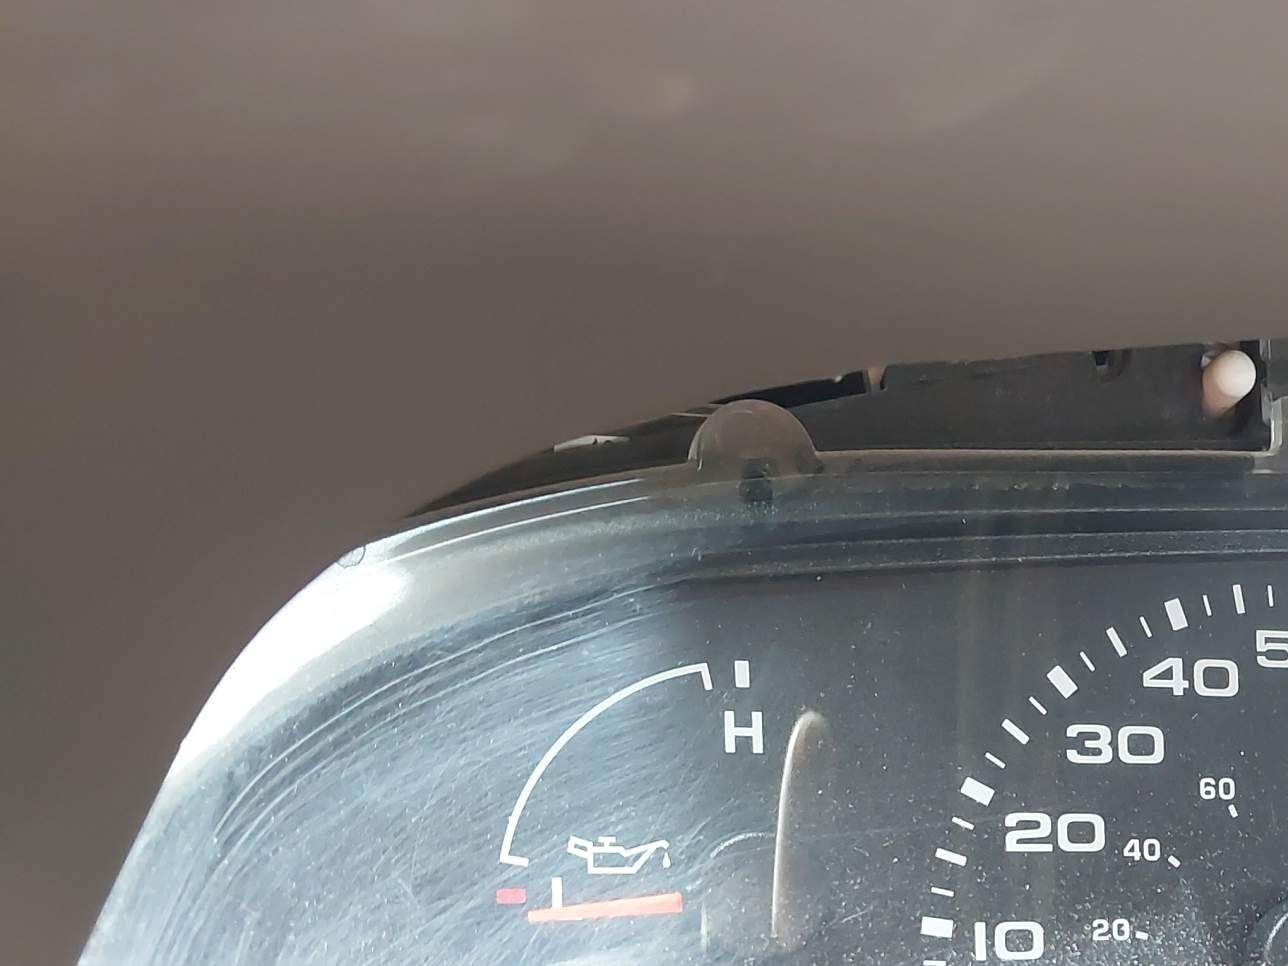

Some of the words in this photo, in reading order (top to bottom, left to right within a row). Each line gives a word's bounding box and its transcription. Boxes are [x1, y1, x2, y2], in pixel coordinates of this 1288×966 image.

[1142, 657, 1240, 698] 40
[723, 711, 764, 754] H
[1065, 723, 1165, 765] 30
[1199, 776, 1237, 801] 60
[1003, 812, 1106, 853] 20
[1122, 837, 1162, 862] 40
[974, 921, 1045, 961] 10
[1091, 918, 1131, 942] 20
